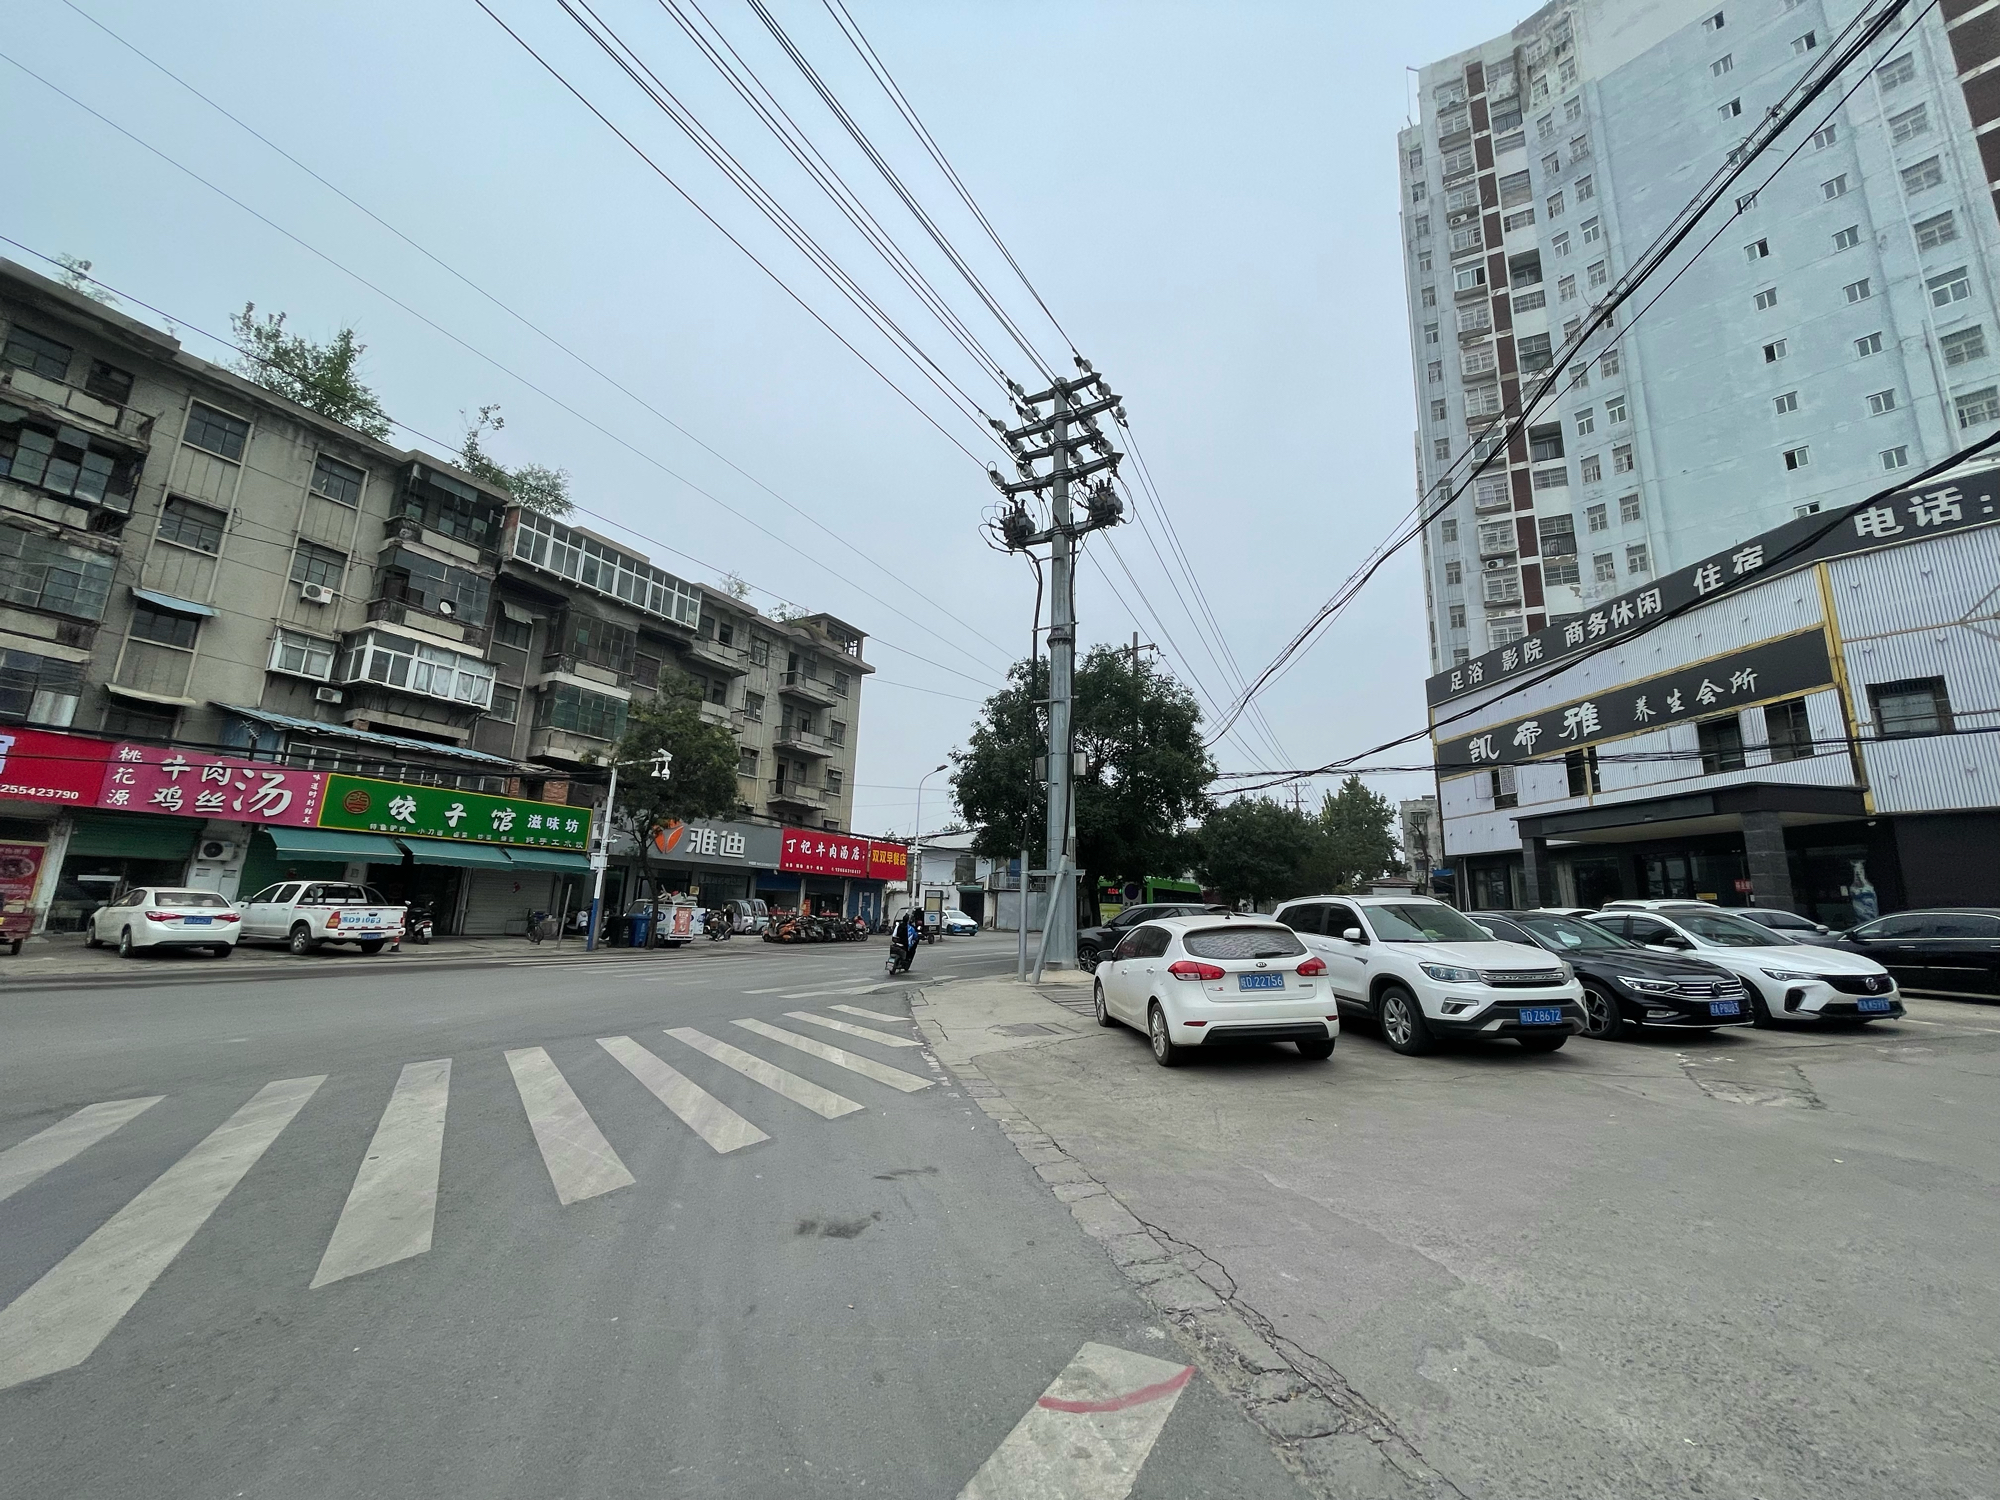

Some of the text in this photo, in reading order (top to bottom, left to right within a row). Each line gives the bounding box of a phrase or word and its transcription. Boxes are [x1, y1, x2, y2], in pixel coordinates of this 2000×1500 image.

[1450, 661, 1484, 693] 足浴
[1501, 637, 1544, 672] 影院
[1563, 587, 1663, 648] 商务休闲
[1693, 544, 1765, 595] 住宿
[1633, 667, 1759, 723] 养生会所
[106, 746, 143, 806] 桃花源
[147, 785, 227, 813] 鸡丝
[160, 754, 293, 817] 牛肉 汤
[388, 795, 580, 833] 饺子馆 滋味坊
[686, 827, 746, 858] 雅迪
[872, 849, 907, 866] 双双早餐店
